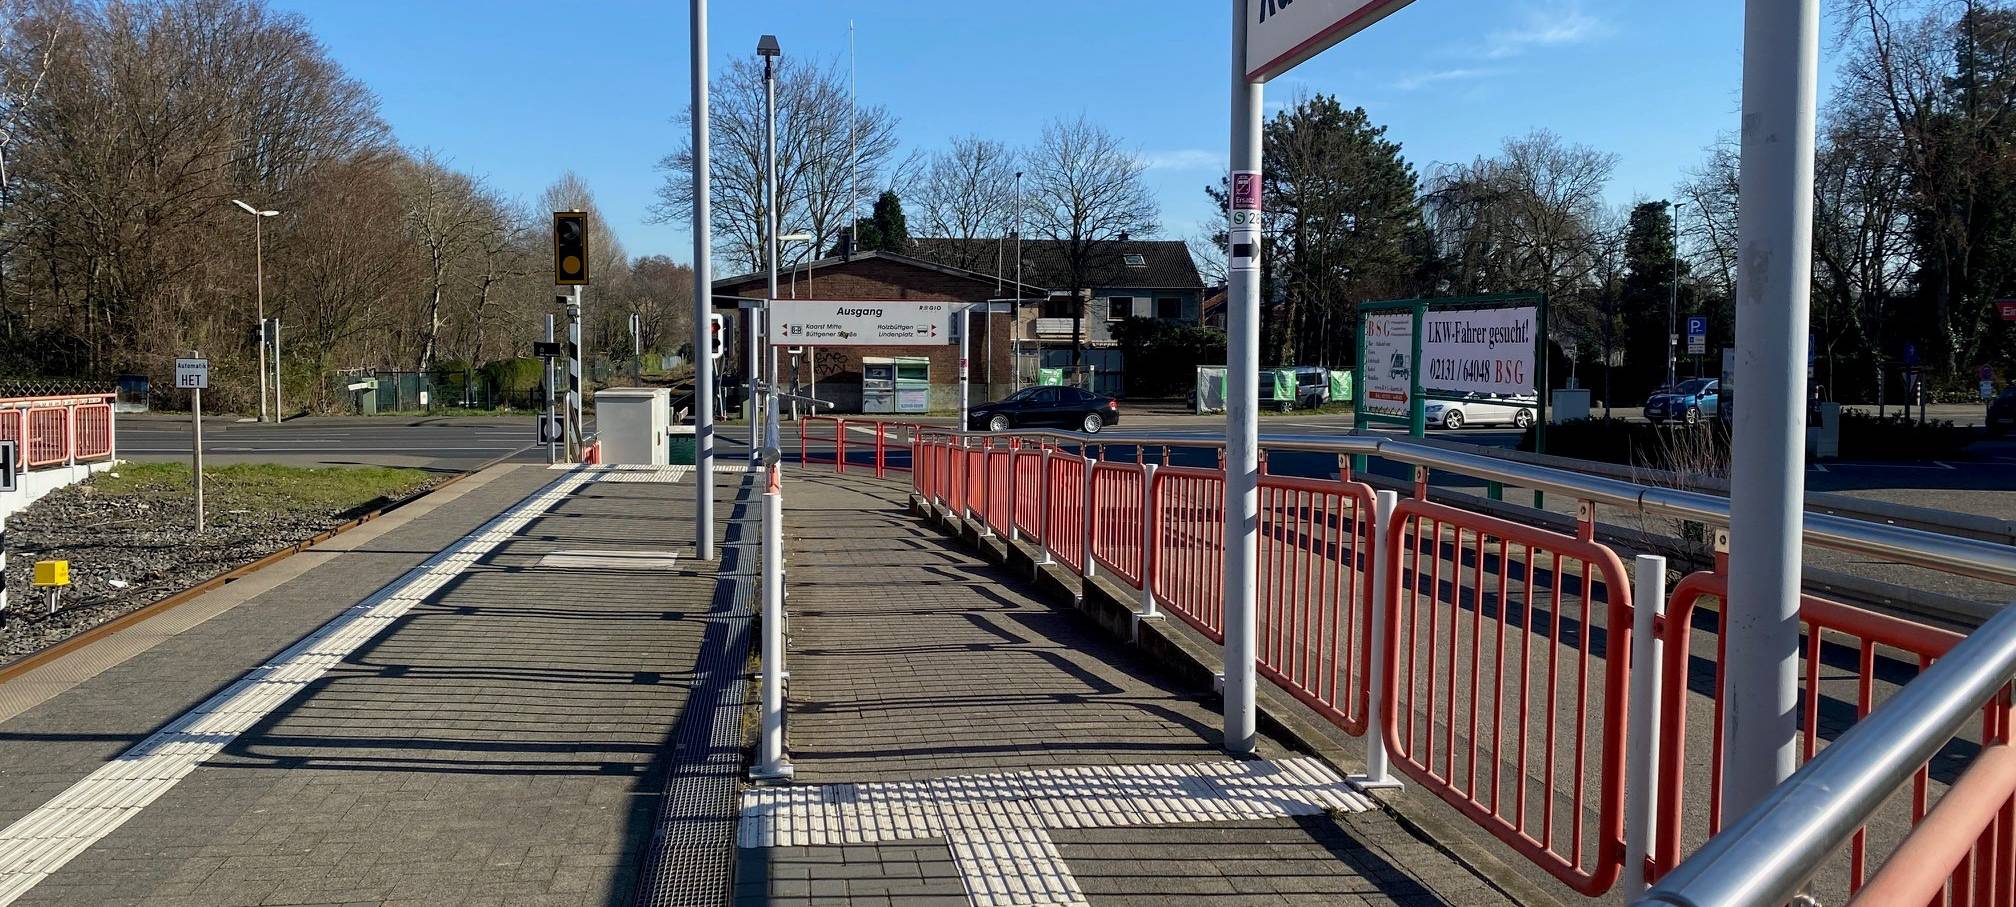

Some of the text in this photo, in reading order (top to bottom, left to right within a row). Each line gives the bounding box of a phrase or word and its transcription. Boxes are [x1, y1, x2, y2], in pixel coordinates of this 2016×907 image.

[836, 306, 883, 318] Ausgang
[877, 323, 914, 331] Holzbüttgen
[1690, 320, 1701, 334] P
[1427, 318, 1529, 350] LKW-Fahrer gesucht!
[181, 374, 201, 386] HET
